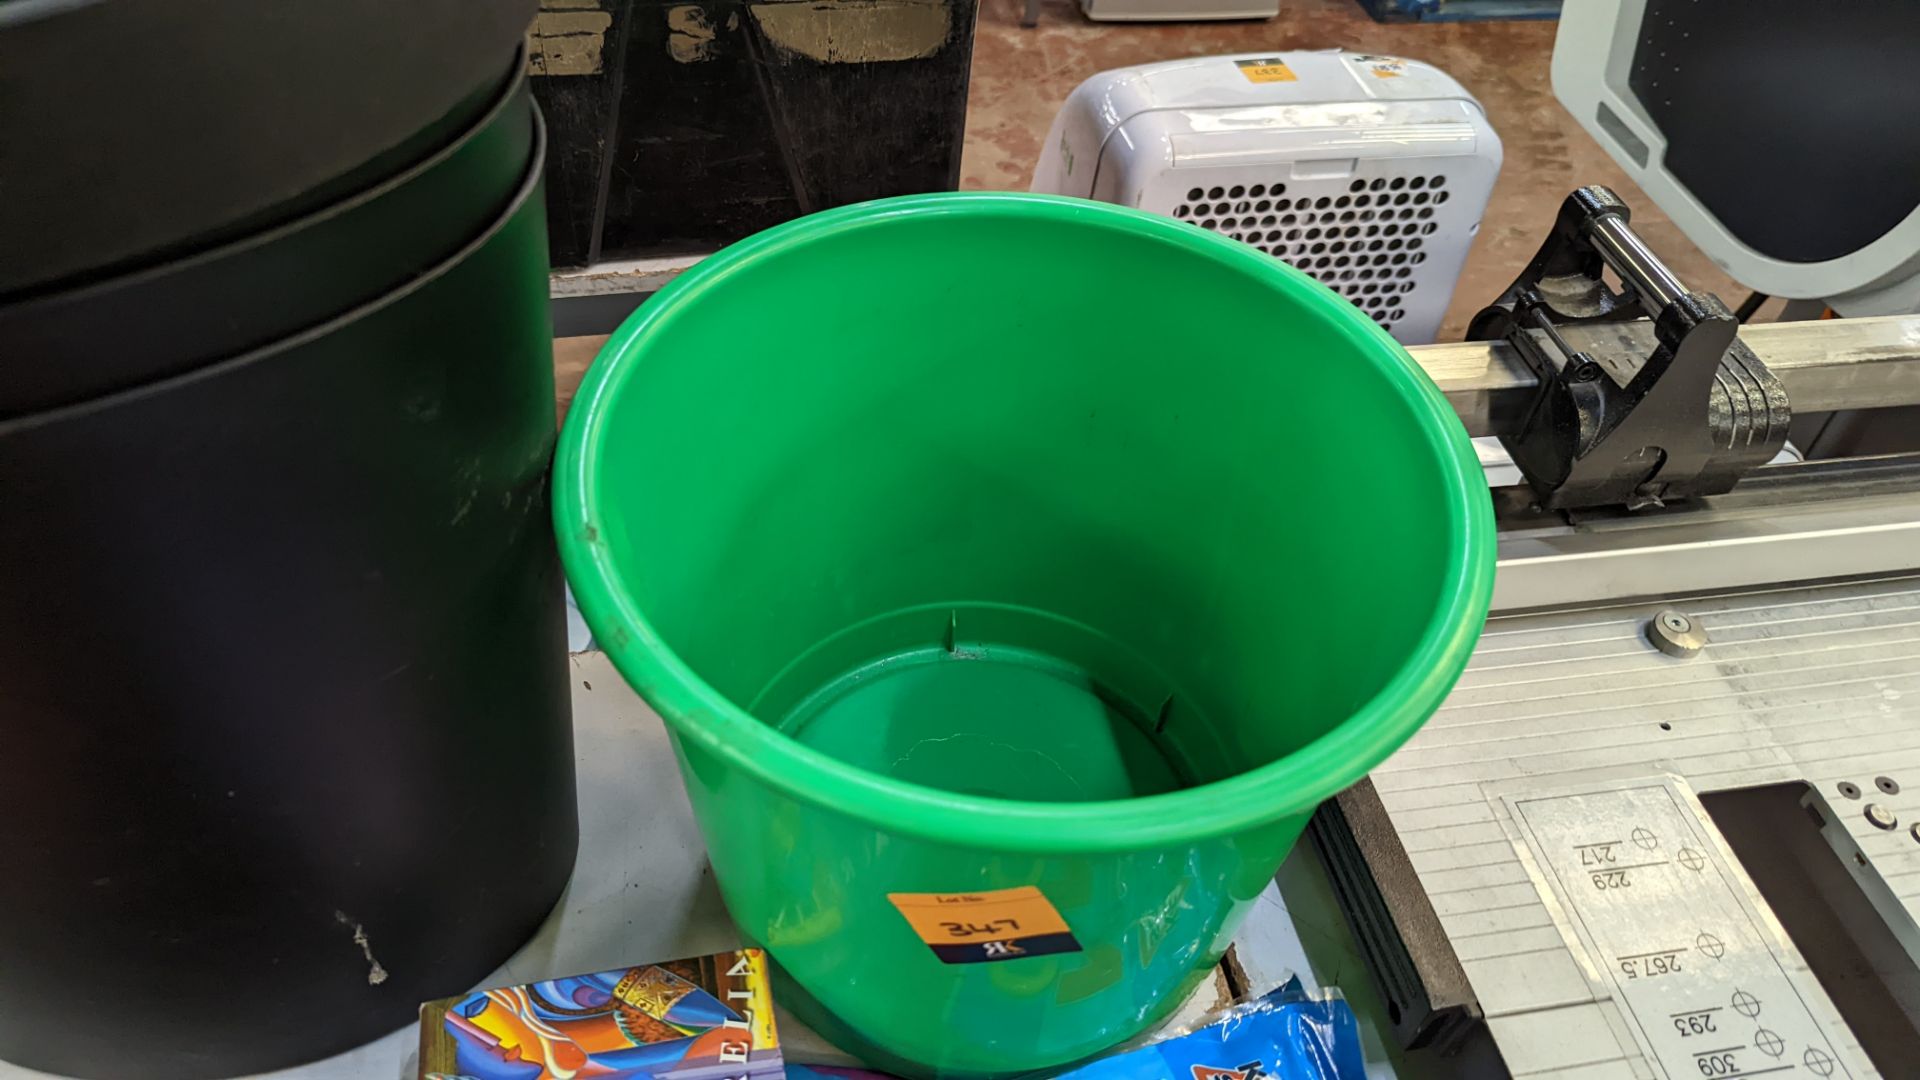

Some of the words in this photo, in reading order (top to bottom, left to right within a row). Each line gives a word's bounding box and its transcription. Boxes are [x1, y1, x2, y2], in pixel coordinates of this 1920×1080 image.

[1581, 845, 1616, 866] 217
[1593, 871, 1631, 890] 229
[939, 919, 1020, 937] 347
[1620, 954, 1682, 978] 267.5
[1674, 1014, 1716, 1037] 293
[1697, 1053, 1740, 1076] 309
